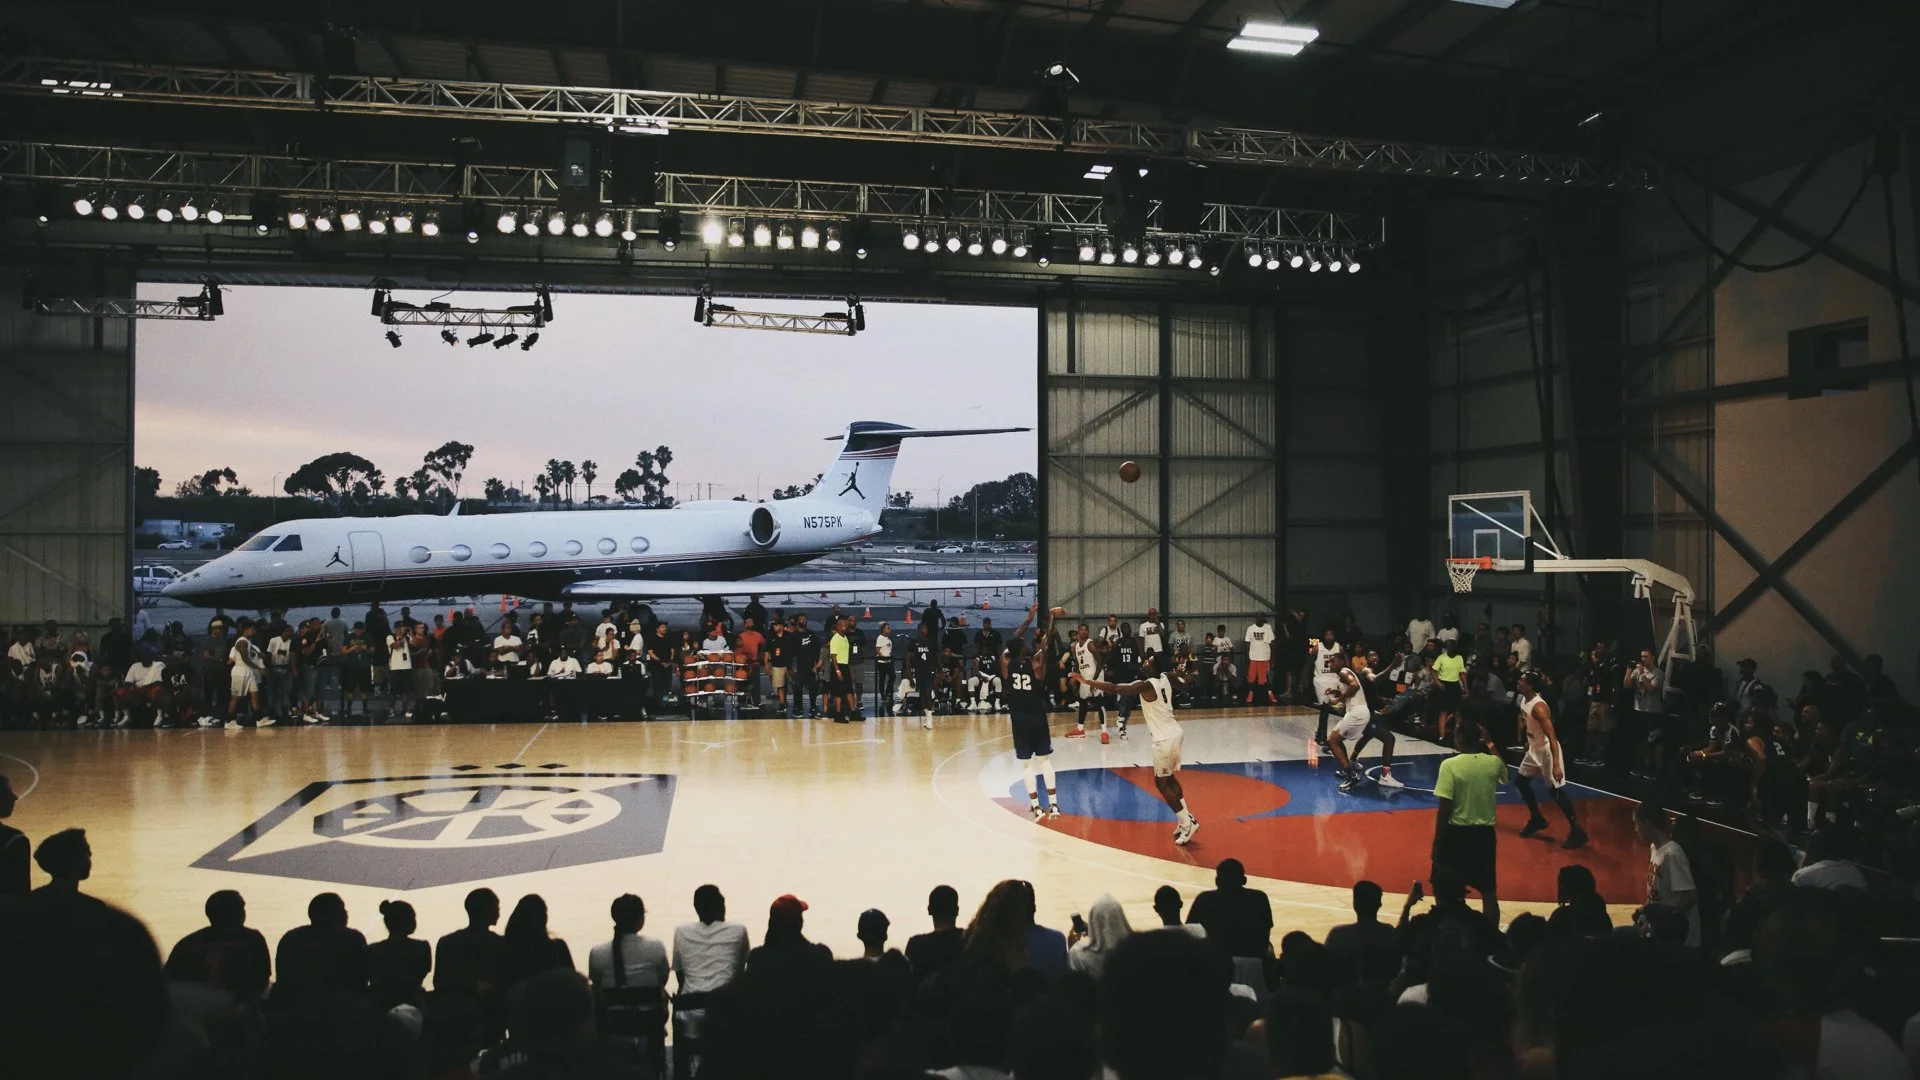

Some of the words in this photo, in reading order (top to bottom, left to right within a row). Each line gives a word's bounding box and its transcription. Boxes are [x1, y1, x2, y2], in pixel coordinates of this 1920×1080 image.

[803, 515, 843, 529] N575PK
[920, 652, 927, 661] 4
[1122, 654, 1131, 663] 13
[1011, 672, 1033, 691] 32
